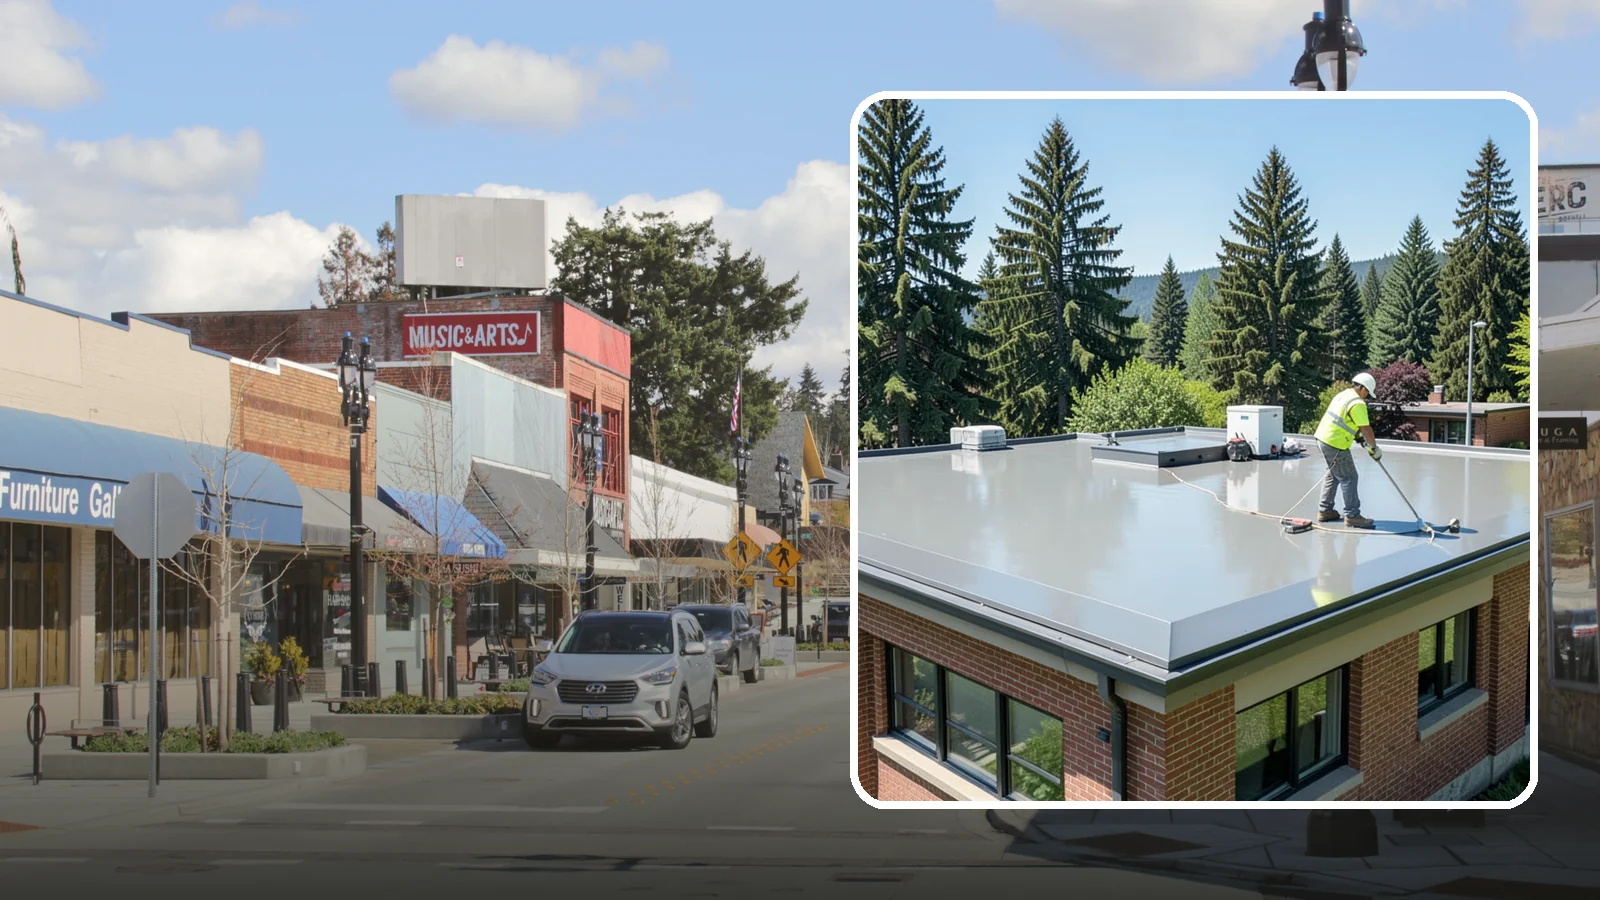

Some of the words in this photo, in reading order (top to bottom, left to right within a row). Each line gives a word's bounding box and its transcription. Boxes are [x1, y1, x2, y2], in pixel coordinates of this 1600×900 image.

[408, 322, 520, 349] MUSIC&ARTS
[0, 471, 79, 515] Furniture
[89, 482, 122, 519] Gal
[453, 563, 479, 574] SUSHI
